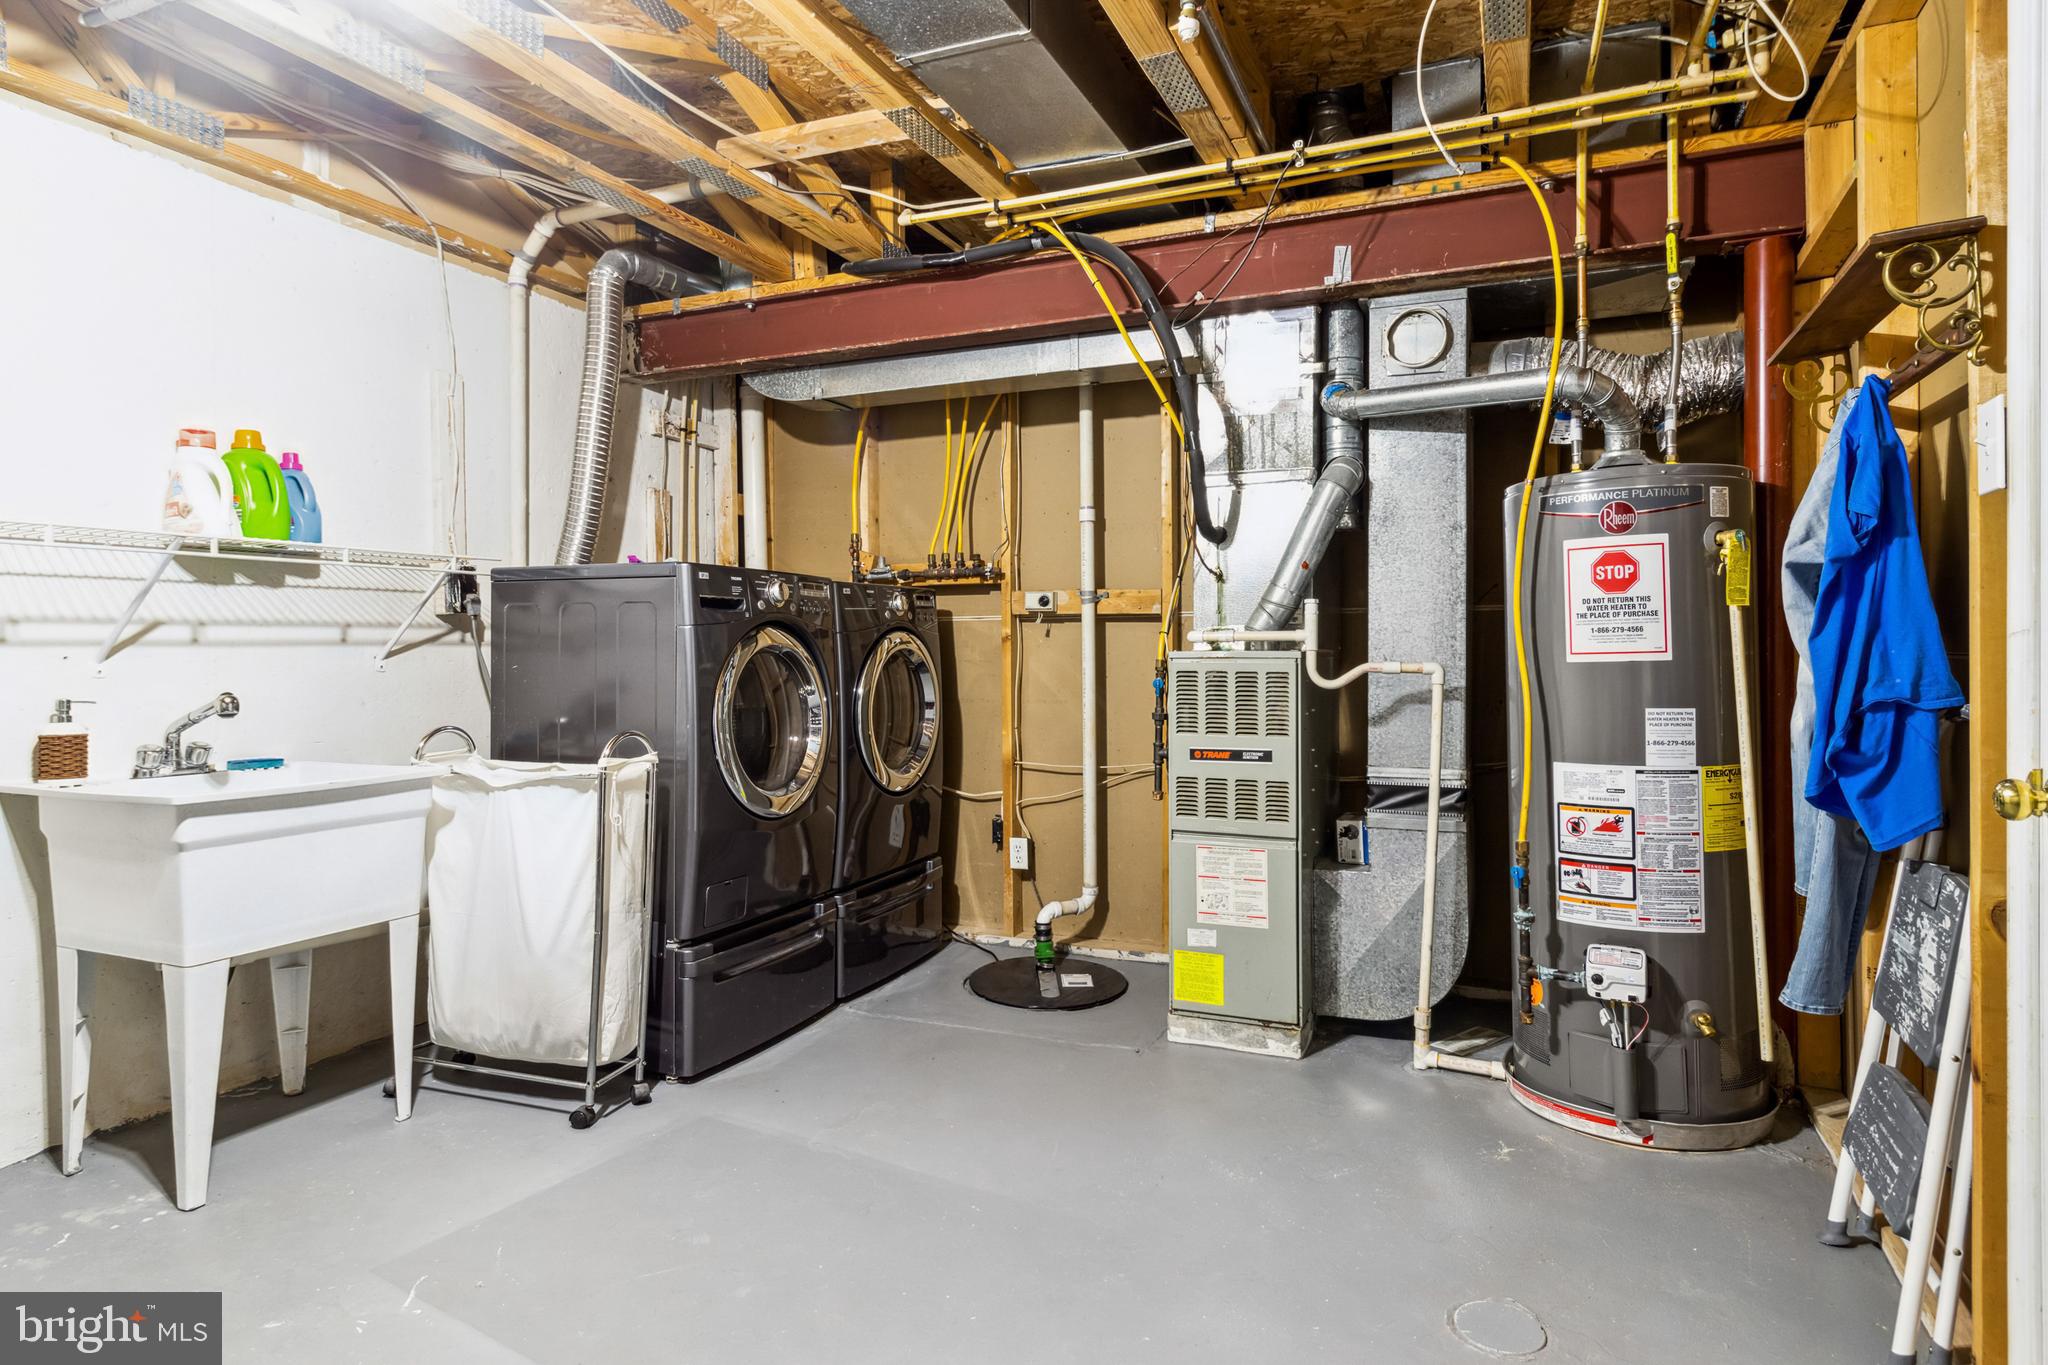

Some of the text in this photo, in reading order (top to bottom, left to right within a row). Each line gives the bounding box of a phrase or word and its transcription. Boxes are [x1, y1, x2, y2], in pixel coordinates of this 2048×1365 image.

[1549, 487, 1690, 506] PERFORMANCE PLATINUM
[1603, 502, 1635, 530] Rheem
[1595, 564, 1635, 580] STOP
[1607, 596, 1634, 604] RETURN
[1586, 604, 1609, 612] WATER
[1610, 603, 1637, 611] HEATER
[1576, 612, 1588, 620] THE
[1589, 611, 1611, 619] PLACE
[1623, 610, 1659, 618] PURCHASE
[1591, 626, 1644, 634] 1-866-279-4566
[1202, 751, 1232, 759] TRANE
